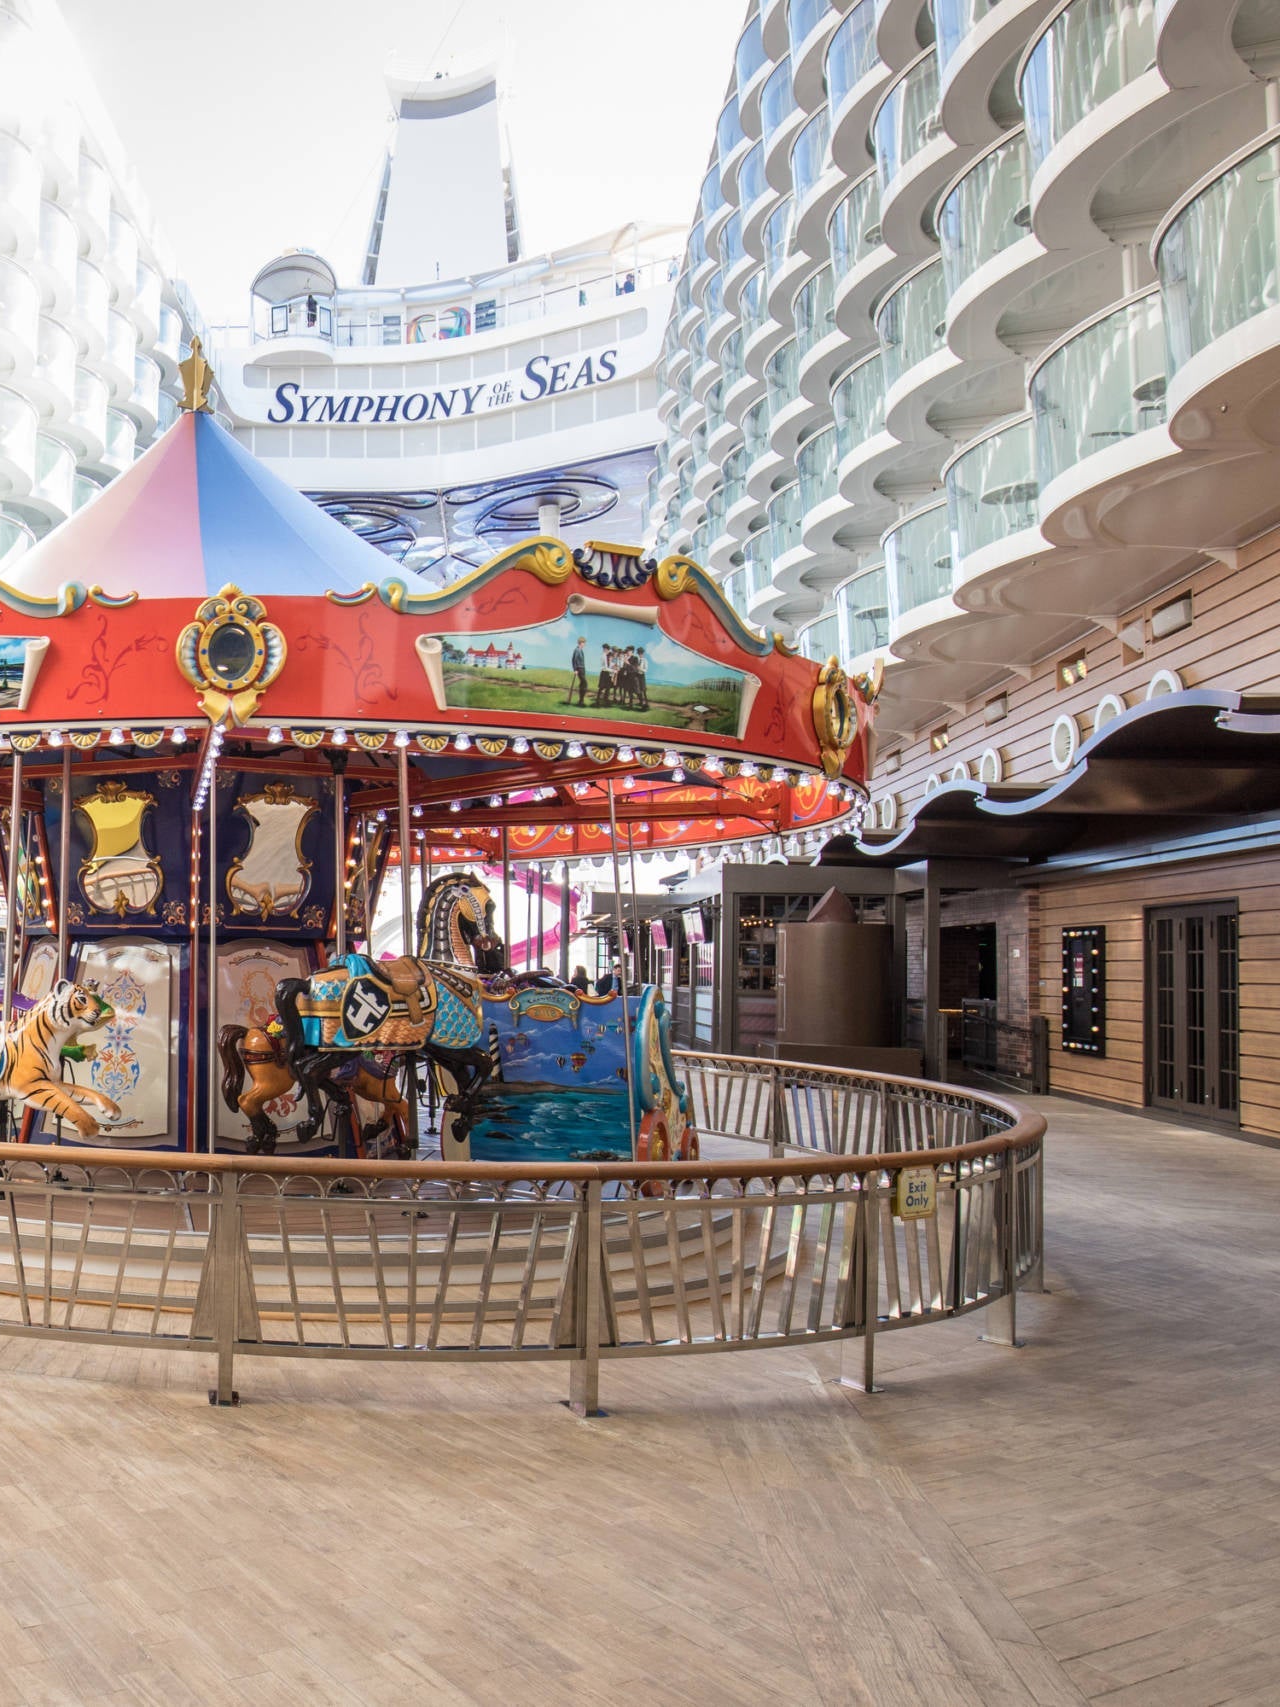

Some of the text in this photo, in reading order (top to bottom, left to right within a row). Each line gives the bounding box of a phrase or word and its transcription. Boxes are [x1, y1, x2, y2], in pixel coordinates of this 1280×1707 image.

[267, 350, 617, 423] SYMPHONY OF THE SEAS
[908, 1180, 927, 1193] Exit
[905, 1194, 929, 1208] Only
